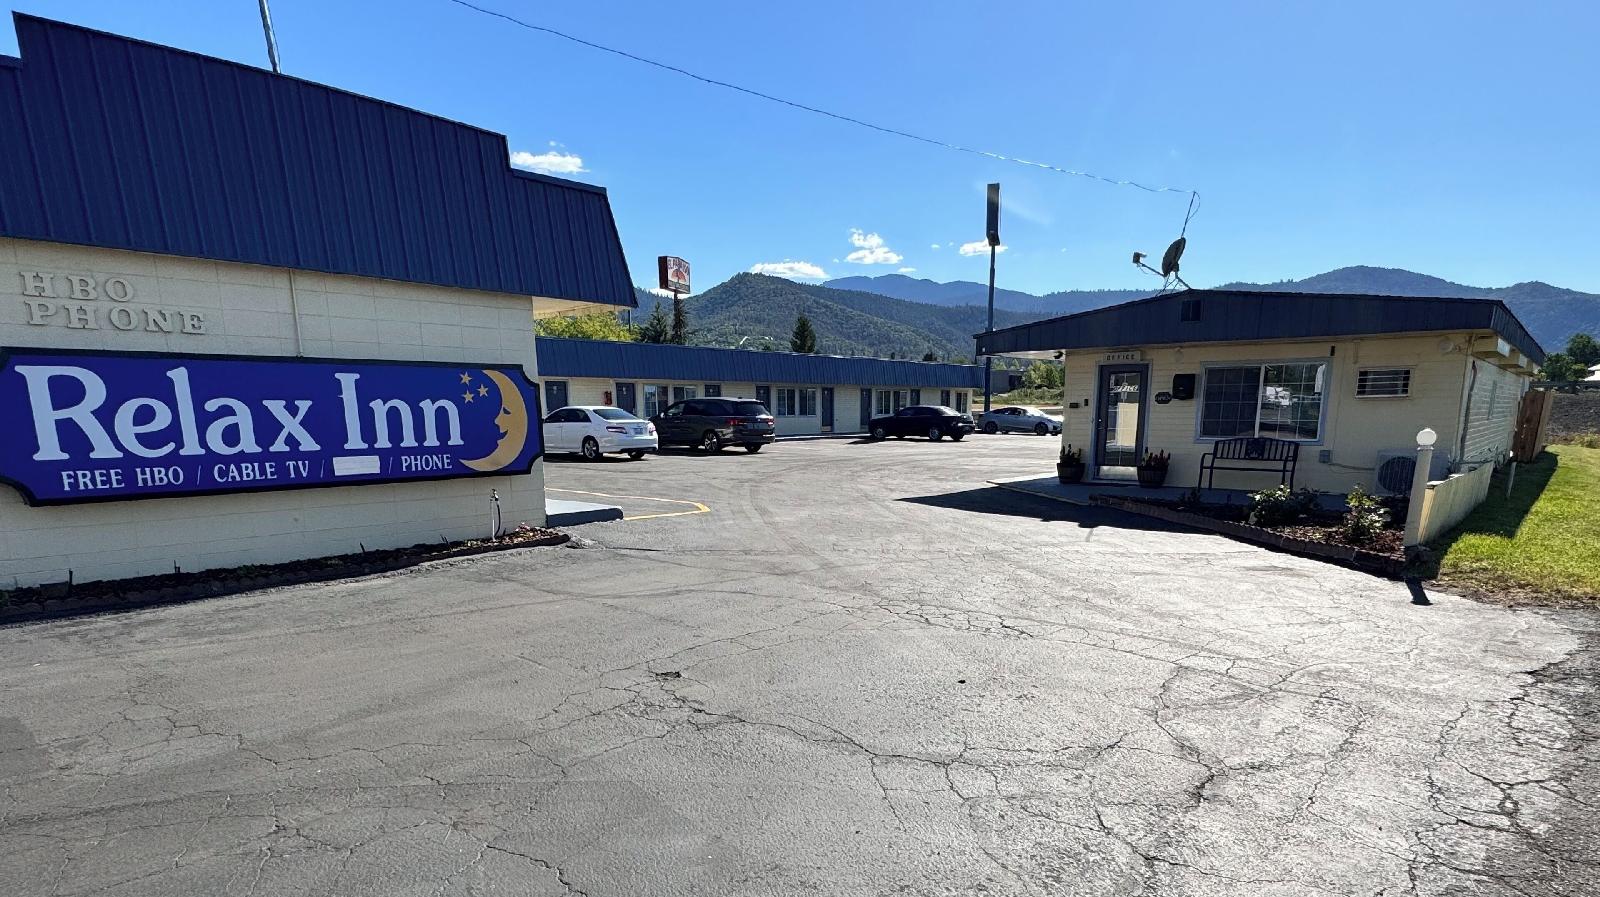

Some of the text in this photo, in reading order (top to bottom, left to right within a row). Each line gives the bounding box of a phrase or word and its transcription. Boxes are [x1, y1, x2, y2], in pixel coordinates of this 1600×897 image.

[19, 271, 135, 302] HBO
[24, 300, 207, 335] PHONE
[1106, 353, 1136, 361] OFFICE
[14, 365, 465, 461] Relax Inn
[61, 468, 125, 491] FREE
[136, 465, 184, 487] HBO
[213, 461, 278, 482] CABLE
[286, 460, 310, 479] TV
[401, 454, 453, 472] PHONE
